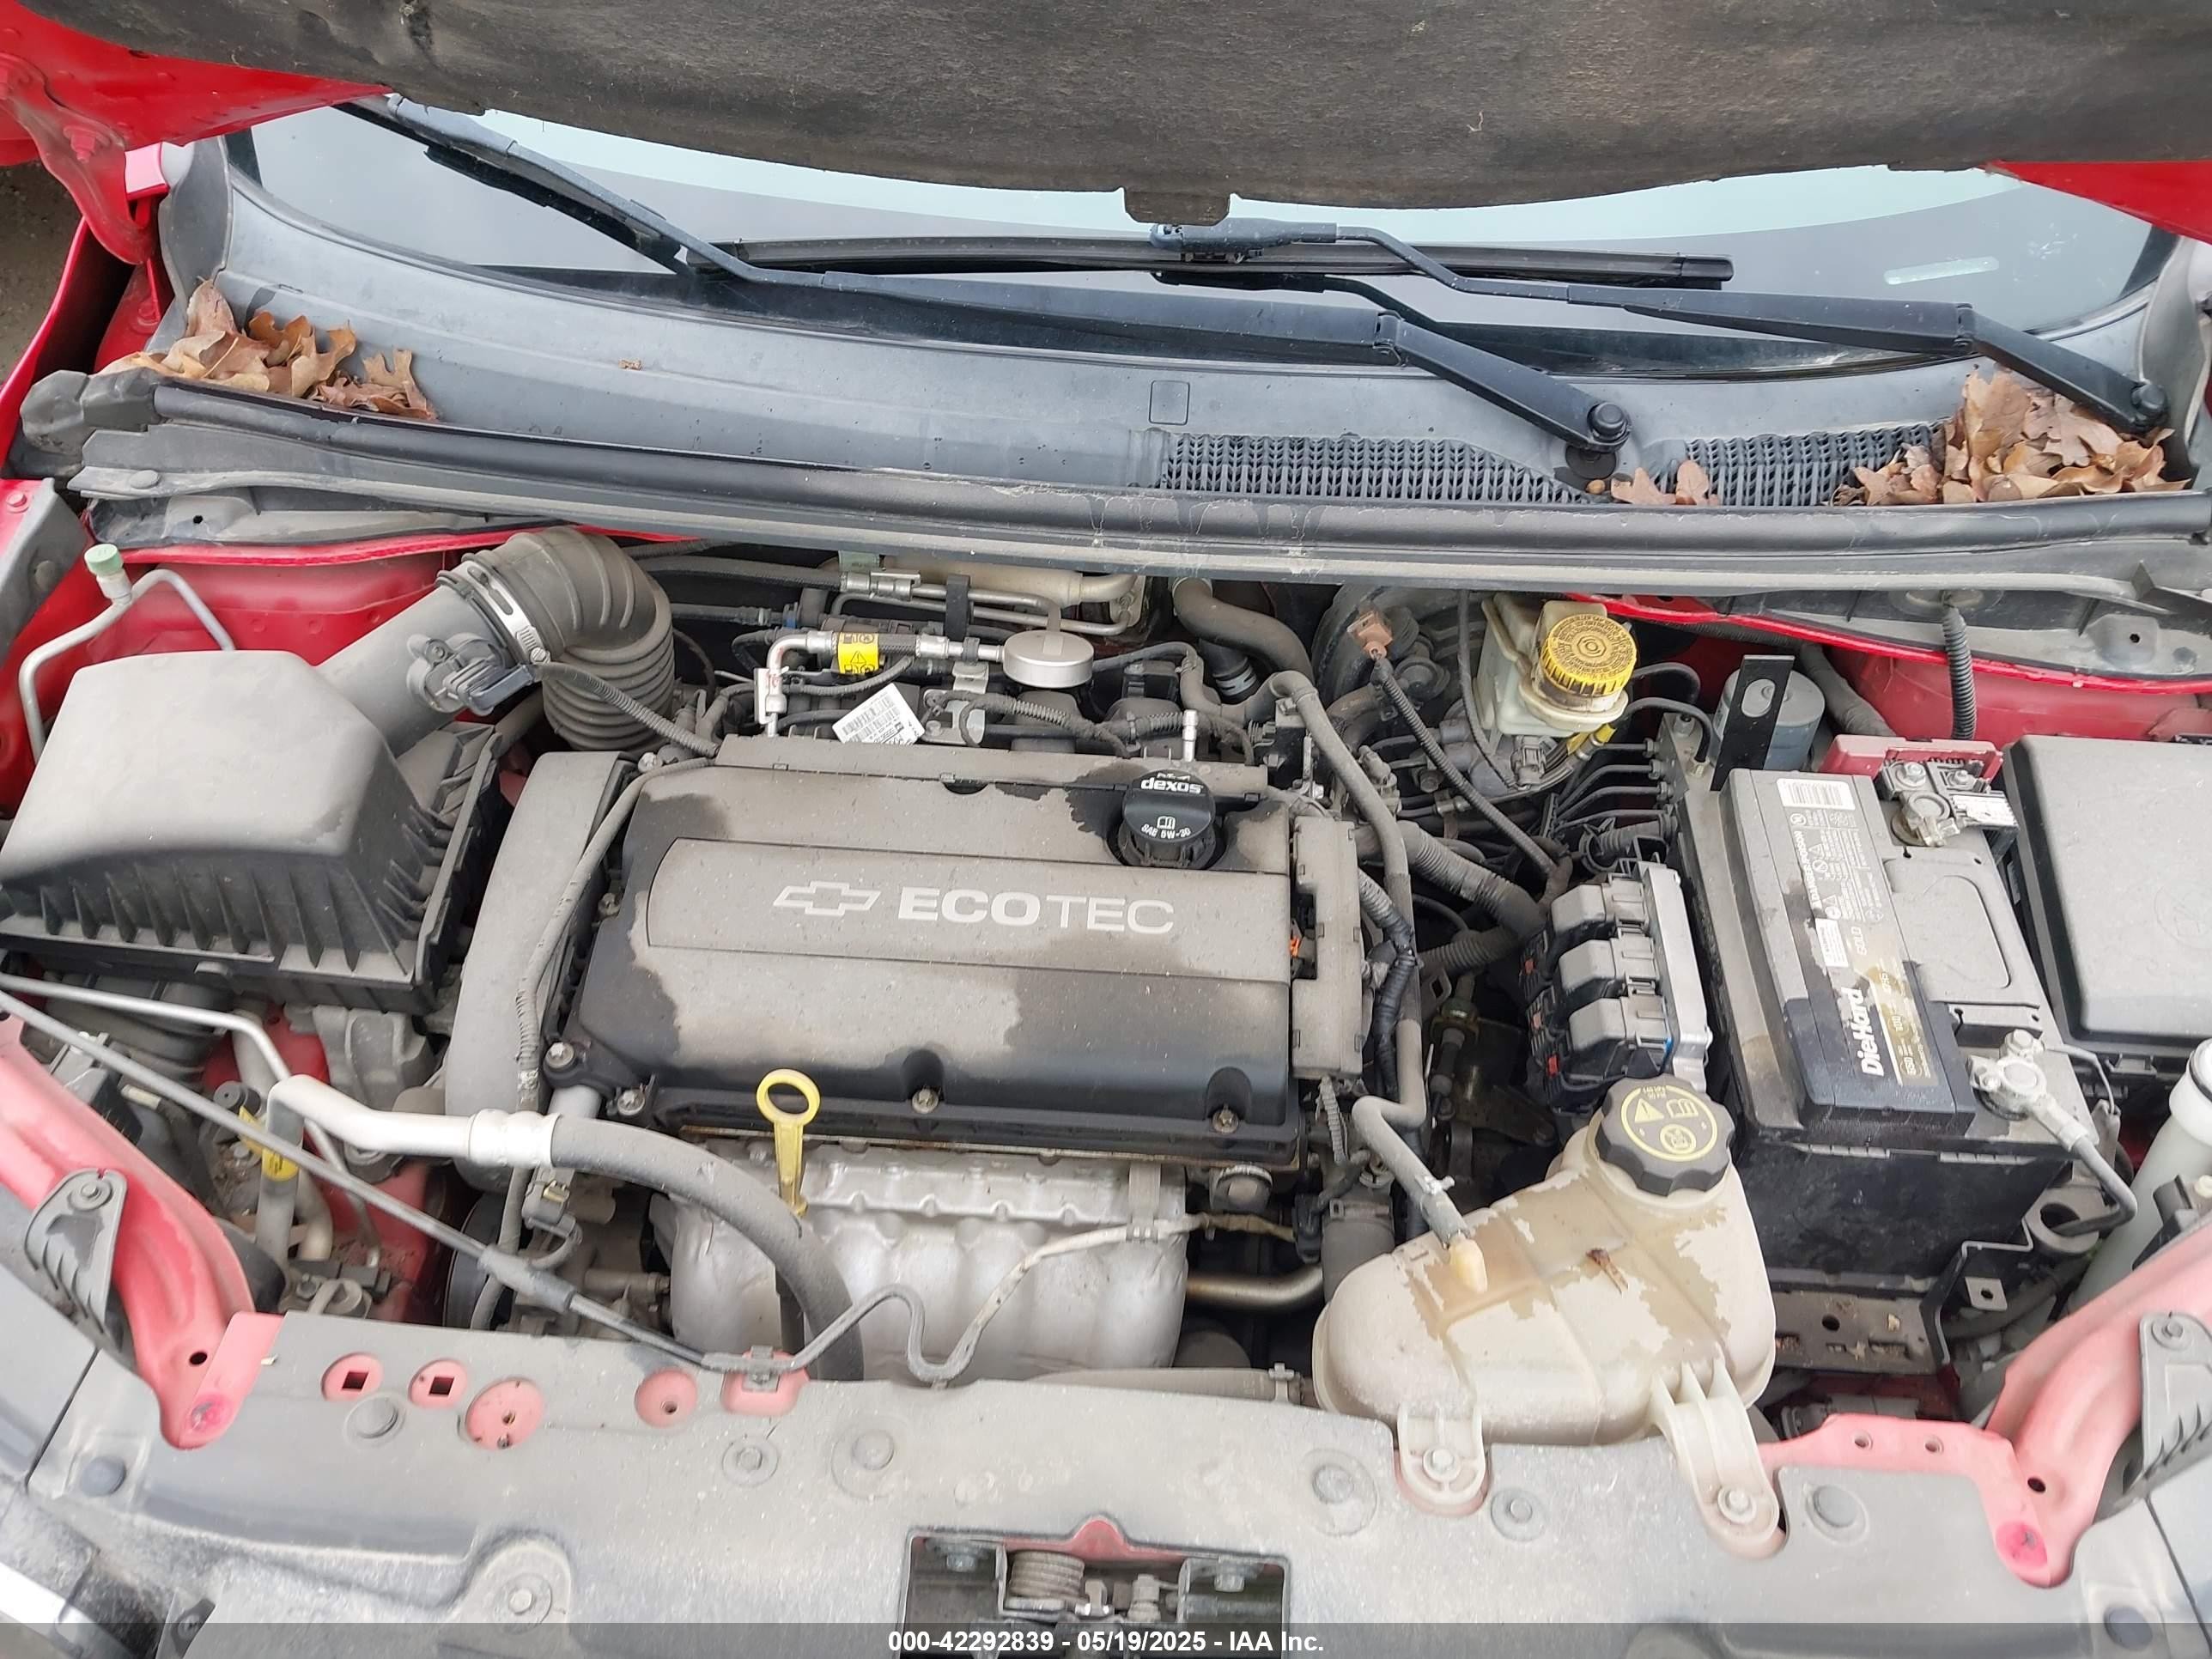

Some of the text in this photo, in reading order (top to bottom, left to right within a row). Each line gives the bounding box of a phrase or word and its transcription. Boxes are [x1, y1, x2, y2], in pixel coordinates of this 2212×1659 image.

[1140, 776, 1202, 794] dexos
[1141, 823, 1158, 837] SAE
[898, 886, 1175, 935] ECOTEC
[1841, 987, 1885, 1077] DieHard
